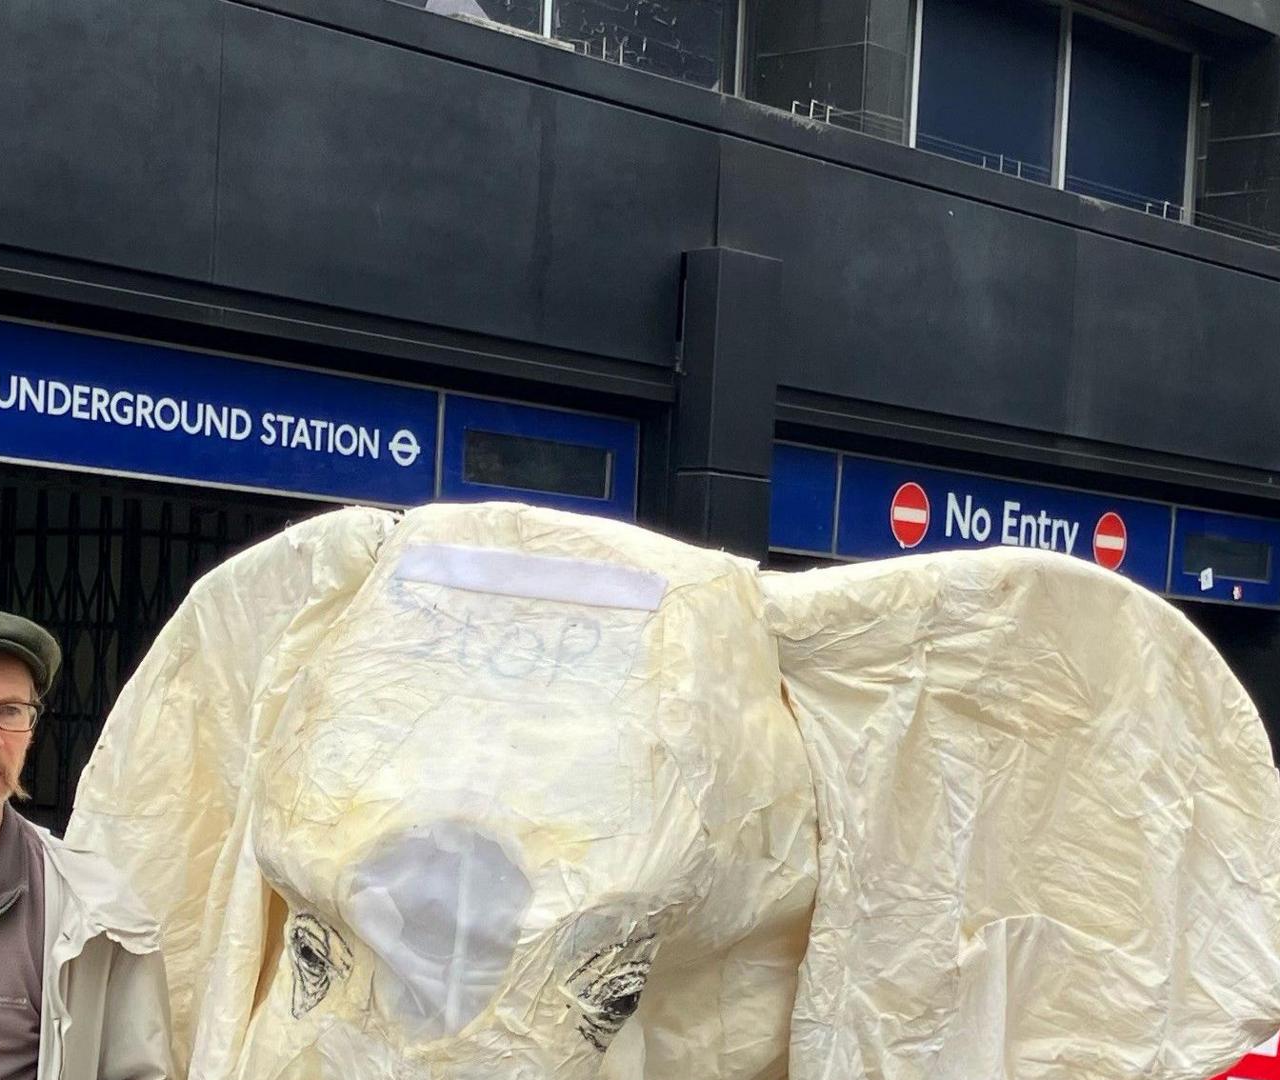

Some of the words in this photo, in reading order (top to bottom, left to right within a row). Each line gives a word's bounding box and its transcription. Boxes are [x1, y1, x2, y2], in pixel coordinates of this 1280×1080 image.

[260, 412, 381, 459] STATION
[945, 492, 992, 542] No
[1001, 500, 1080, 555] Entry
